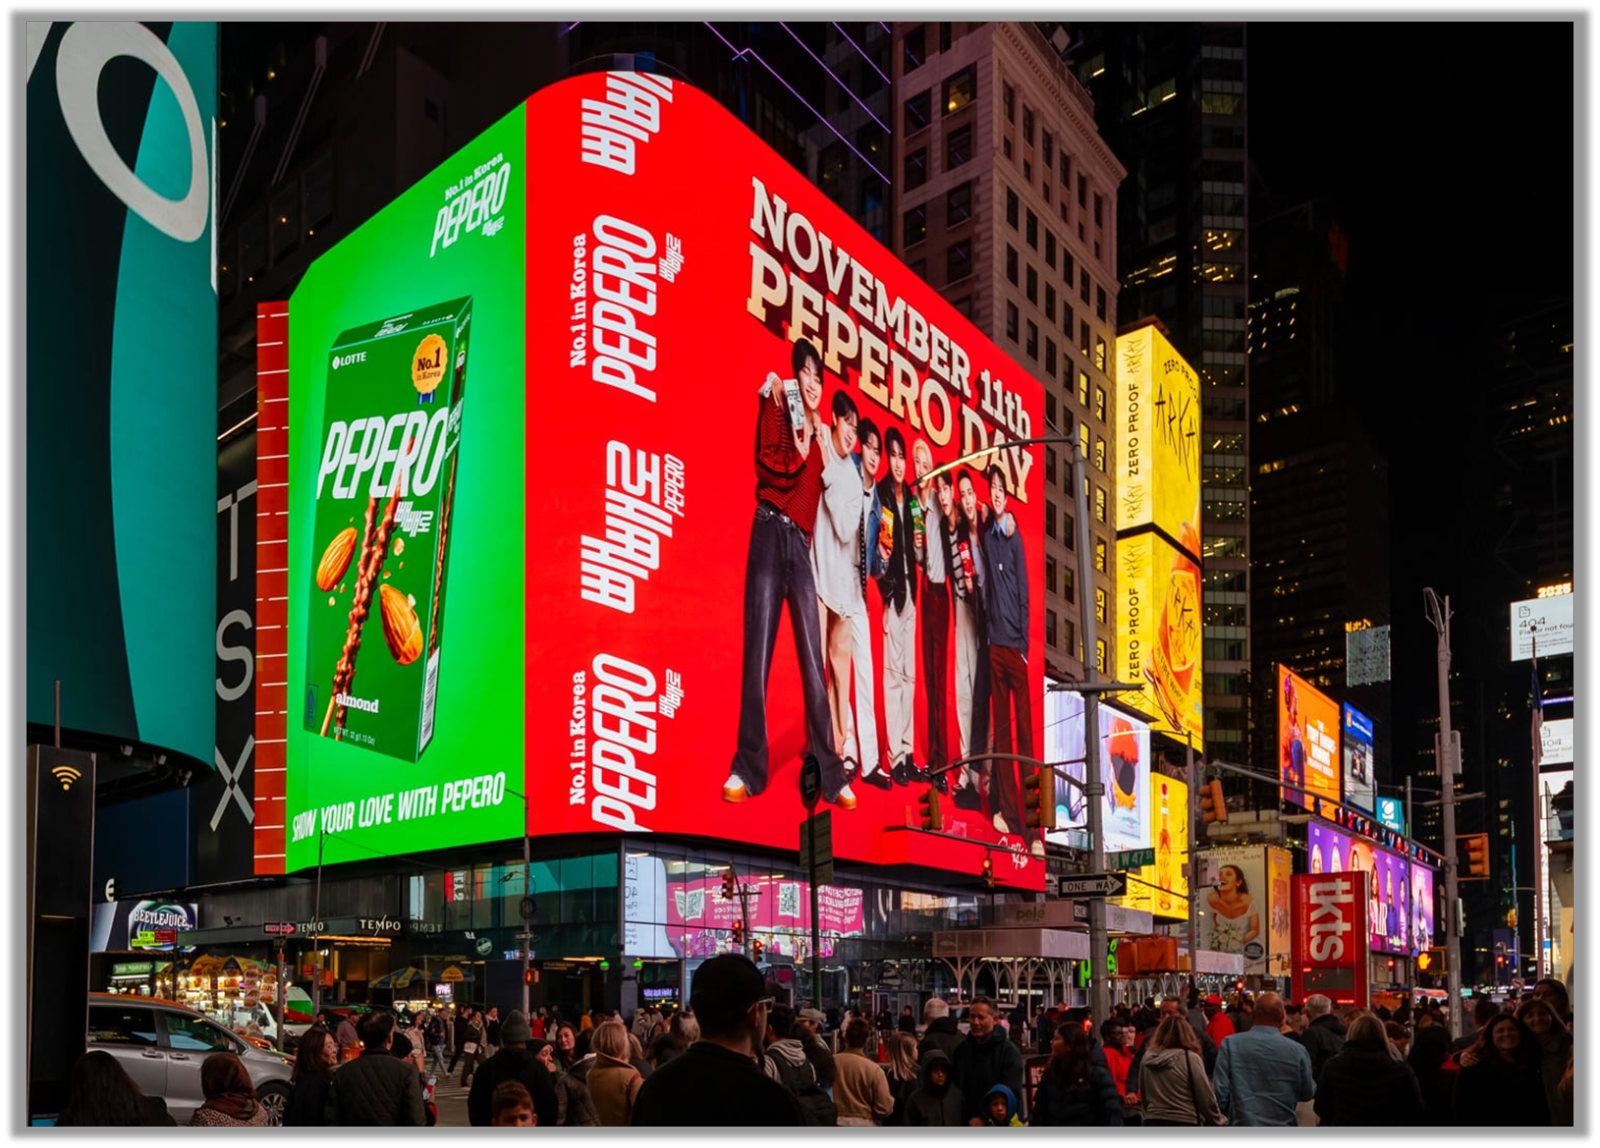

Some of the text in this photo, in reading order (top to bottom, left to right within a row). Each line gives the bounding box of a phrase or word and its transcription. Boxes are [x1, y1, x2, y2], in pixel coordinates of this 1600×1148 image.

[430, 162, 510, 258] PEPERO
[445, 153, 503, 201] No.1 in Korea
[570, 234, 586, 367] No.1 in Korea
[593, 215, 656, 403] PEPERO
[750, 176, 1032, 446] NOVEMBER 11th
[340, 352, 367, 366] LOTTE
[417, 347, 441, 371] No.1
[747, 241, 1033, 504] PEPERO DAY
[1164, 359, 1180, 375] ZERO
[316, 407, 449, 499] PEPERO
[1128, 384, 1139, 478] ZERO PROOF
[664, 453, 685, 517] PEPERO
[580, 439, 673, 614] 빼빼로
[1519, 617, 1545, 628] 404
[1537, 583, 1571, 598] 2025
[1129, 588, 1139, 679] ZERO PROOF
[1519, 627, 1543, 636] Flaor
[336, 693, 379, 713] almond
[569, 670, 586, 805] No.1 in Korea
[591, 652, 657, 832] PEPERO
[292, 772, 505, 843] SHOW YOUR LOVE WITH PEPERO
[1068, 880, 1115, 891] ONE WAY
[1121, 853, 1130, 866] W
[1132, 850, 1144, 865] 47
[136, 911, 188, 927] BEETLEJUICE
[359, 914, 401, 936] TEMPO
[1309, 878, 1354, 962] tkts
